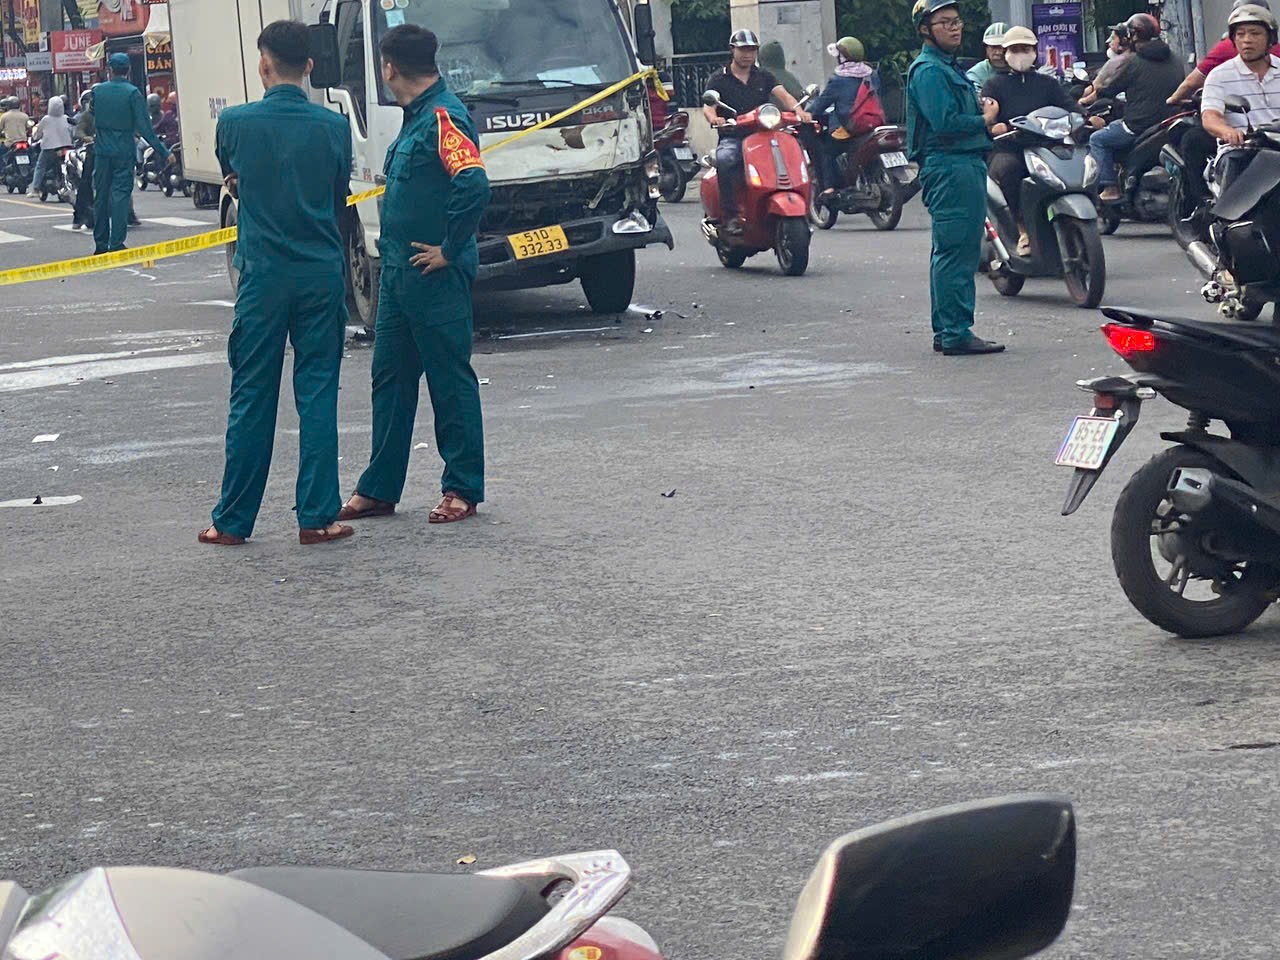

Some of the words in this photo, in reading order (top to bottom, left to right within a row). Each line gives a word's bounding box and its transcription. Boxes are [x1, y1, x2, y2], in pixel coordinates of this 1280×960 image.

[63, 35, 92, 50] JUNE
[486, 112, 552, 130] ISUZU
[519, 239, 563, 257] 332.33
